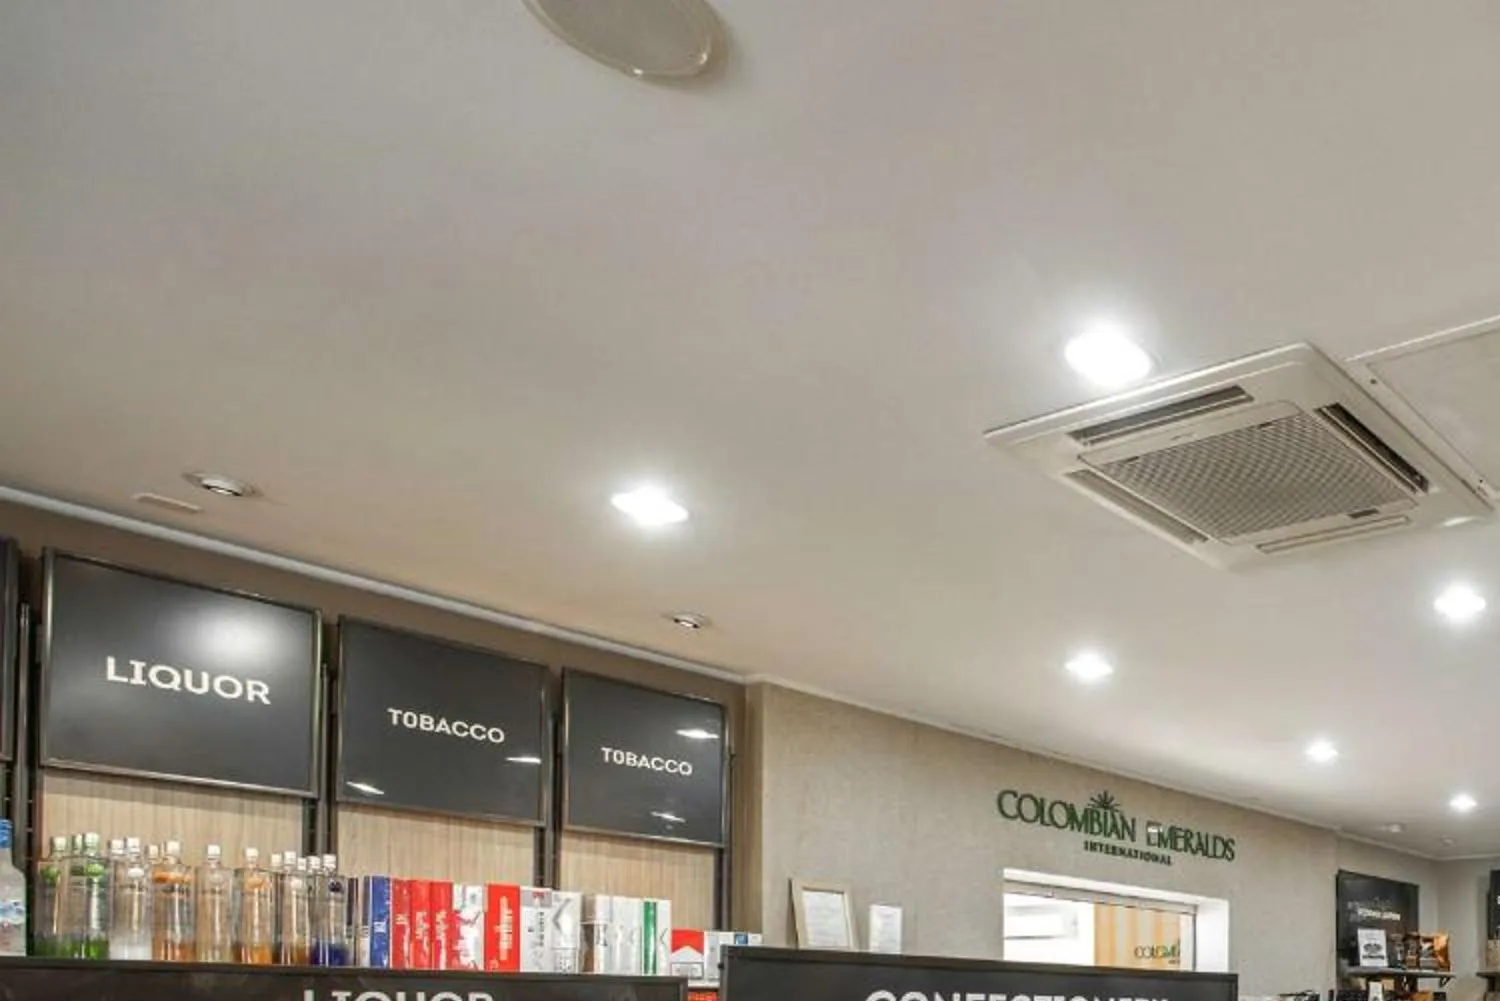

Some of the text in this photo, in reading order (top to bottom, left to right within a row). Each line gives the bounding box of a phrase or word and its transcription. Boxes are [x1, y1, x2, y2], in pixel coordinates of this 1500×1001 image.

[105, 655, 272, 705] LIQUOR
[387, 707, 506, 745] TOBACCO
[600, 746, 694, 777] TOBACCO
[996, 789, 1236, 862] COLOMBIAN EMERALDS
[1083, 840, 1173, 866] INTERNATIONAL
